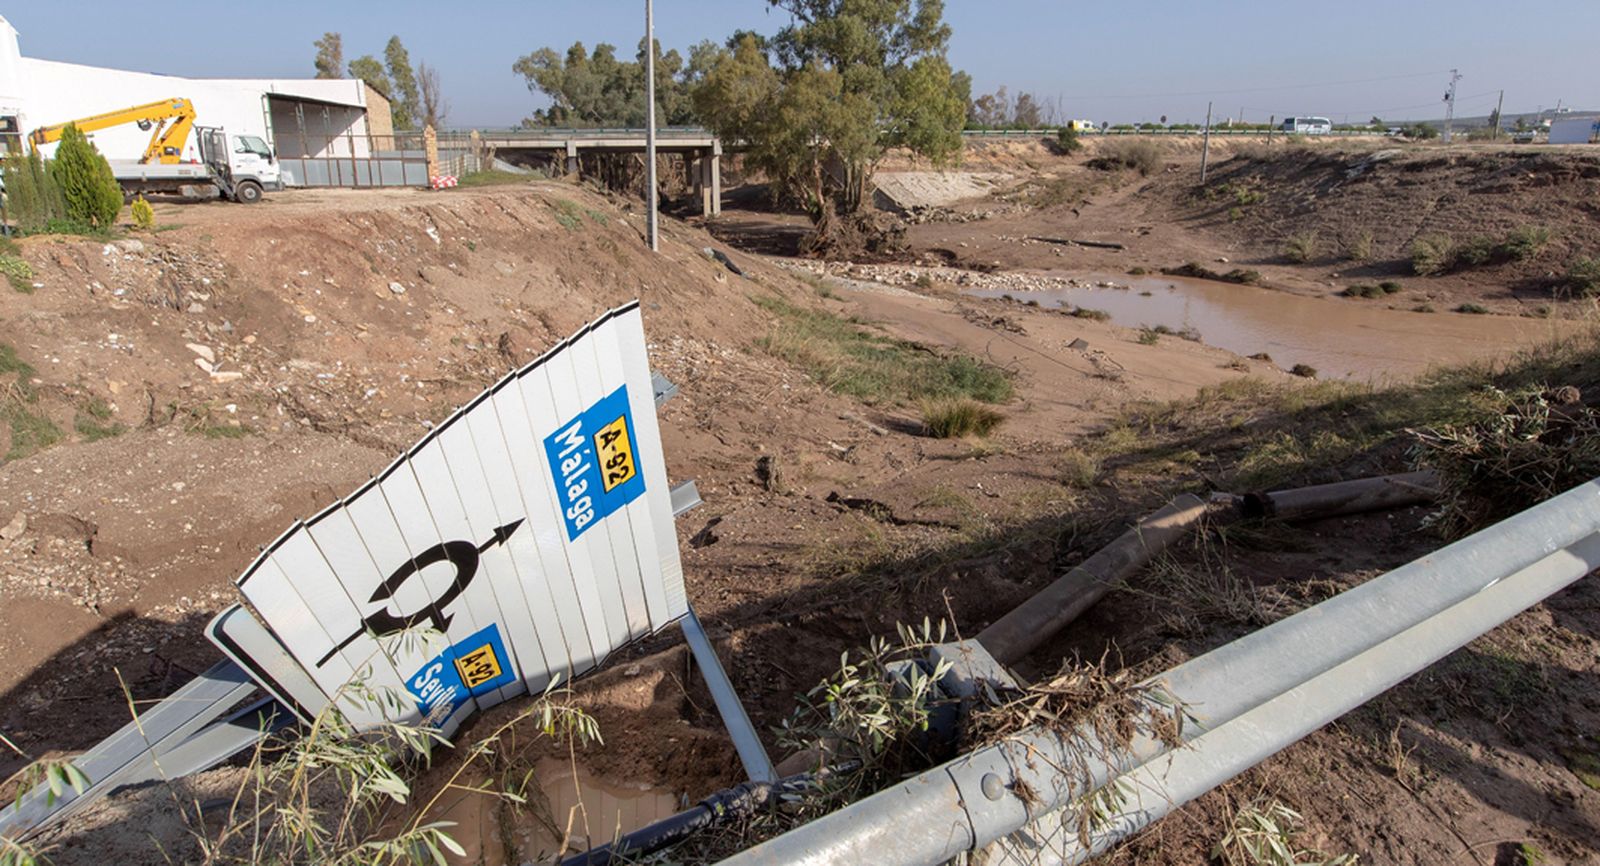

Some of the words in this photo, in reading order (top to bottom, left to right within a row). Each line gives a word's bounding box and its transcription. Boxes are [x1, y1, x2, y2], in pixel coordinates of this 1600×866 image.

[554, 420, 595, 531] Málaga
[600, 429, 629, 485] A-92
[414, 662, 458, 722] Sevill
[461, 650, 495, 685] A-92
